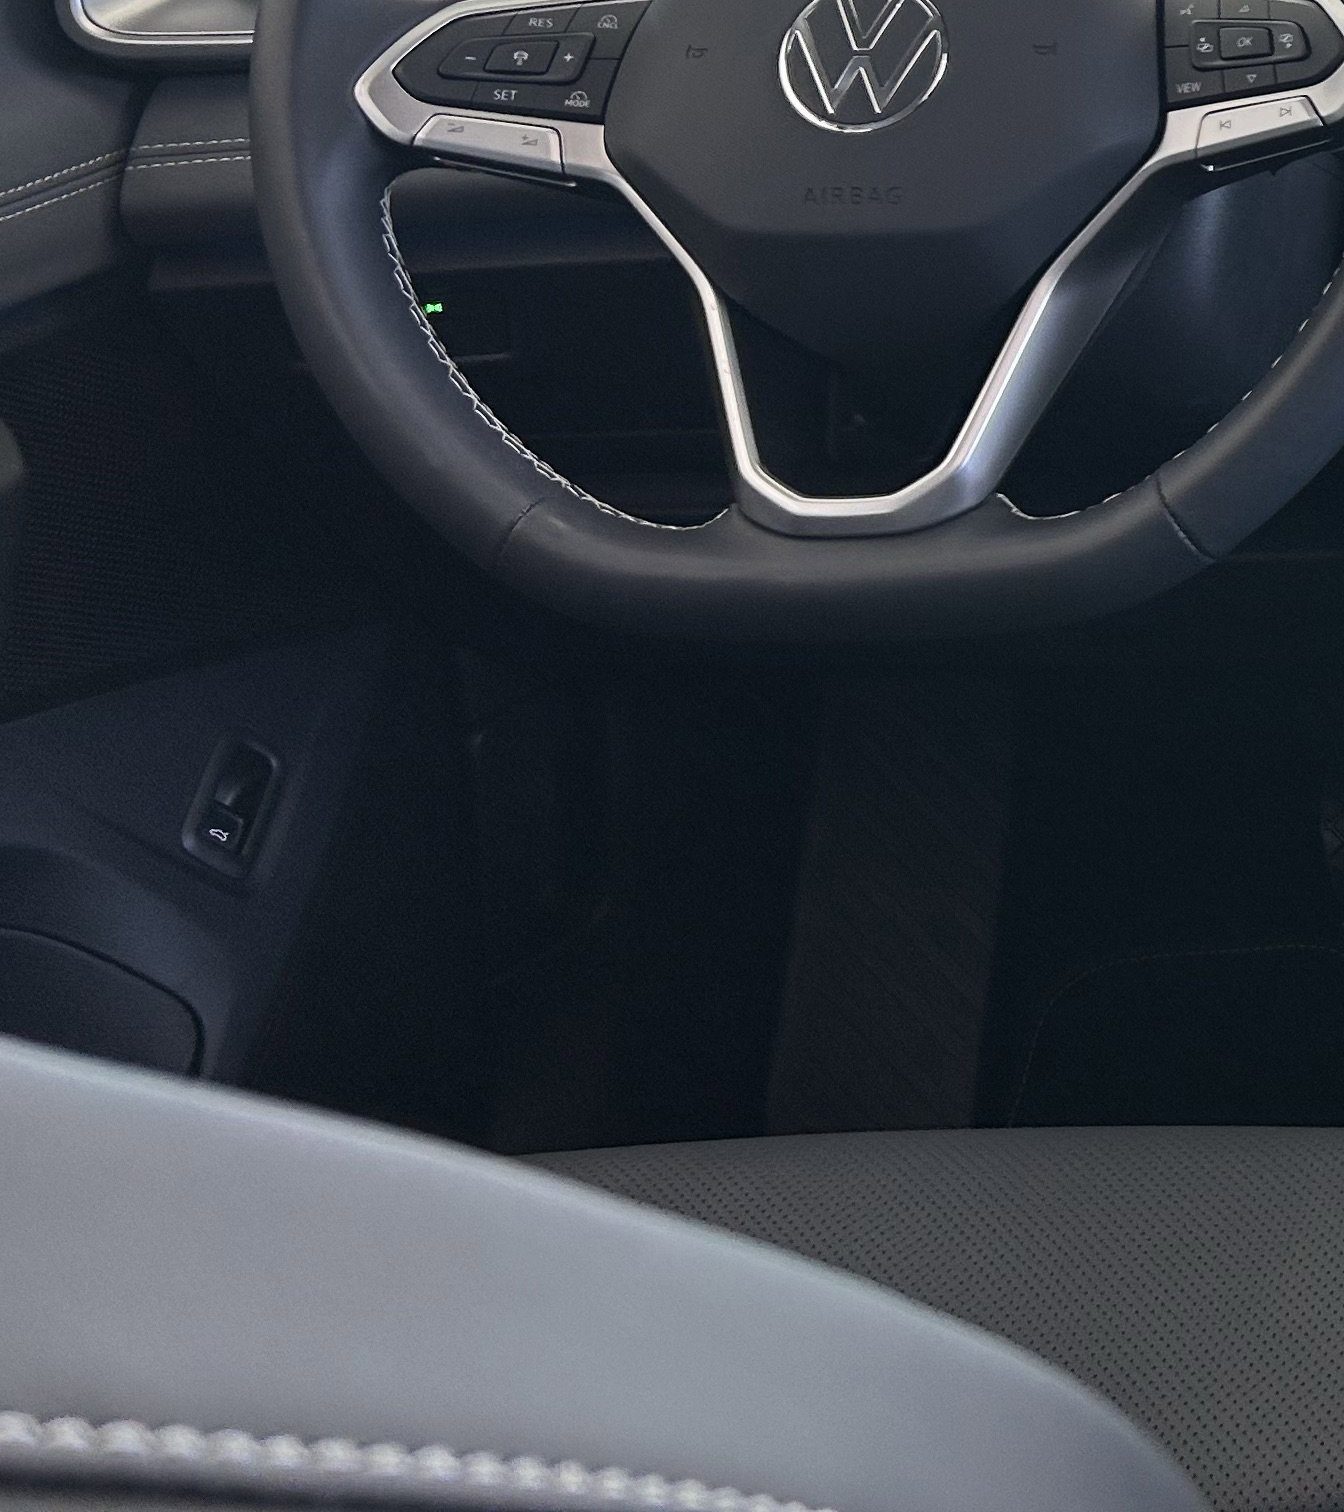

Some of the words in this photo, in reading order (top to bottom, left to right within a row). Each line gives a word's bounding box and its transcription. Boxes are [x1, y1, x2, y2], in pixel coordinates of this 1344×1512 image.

[528, 17, 554, 28] RES
[1237, 36, 1253, 48] OK
[1176, 83, 1202, 94] VIEW
[493, 90, 518, 100] SET
[564, 99, 591, 108] MODE
